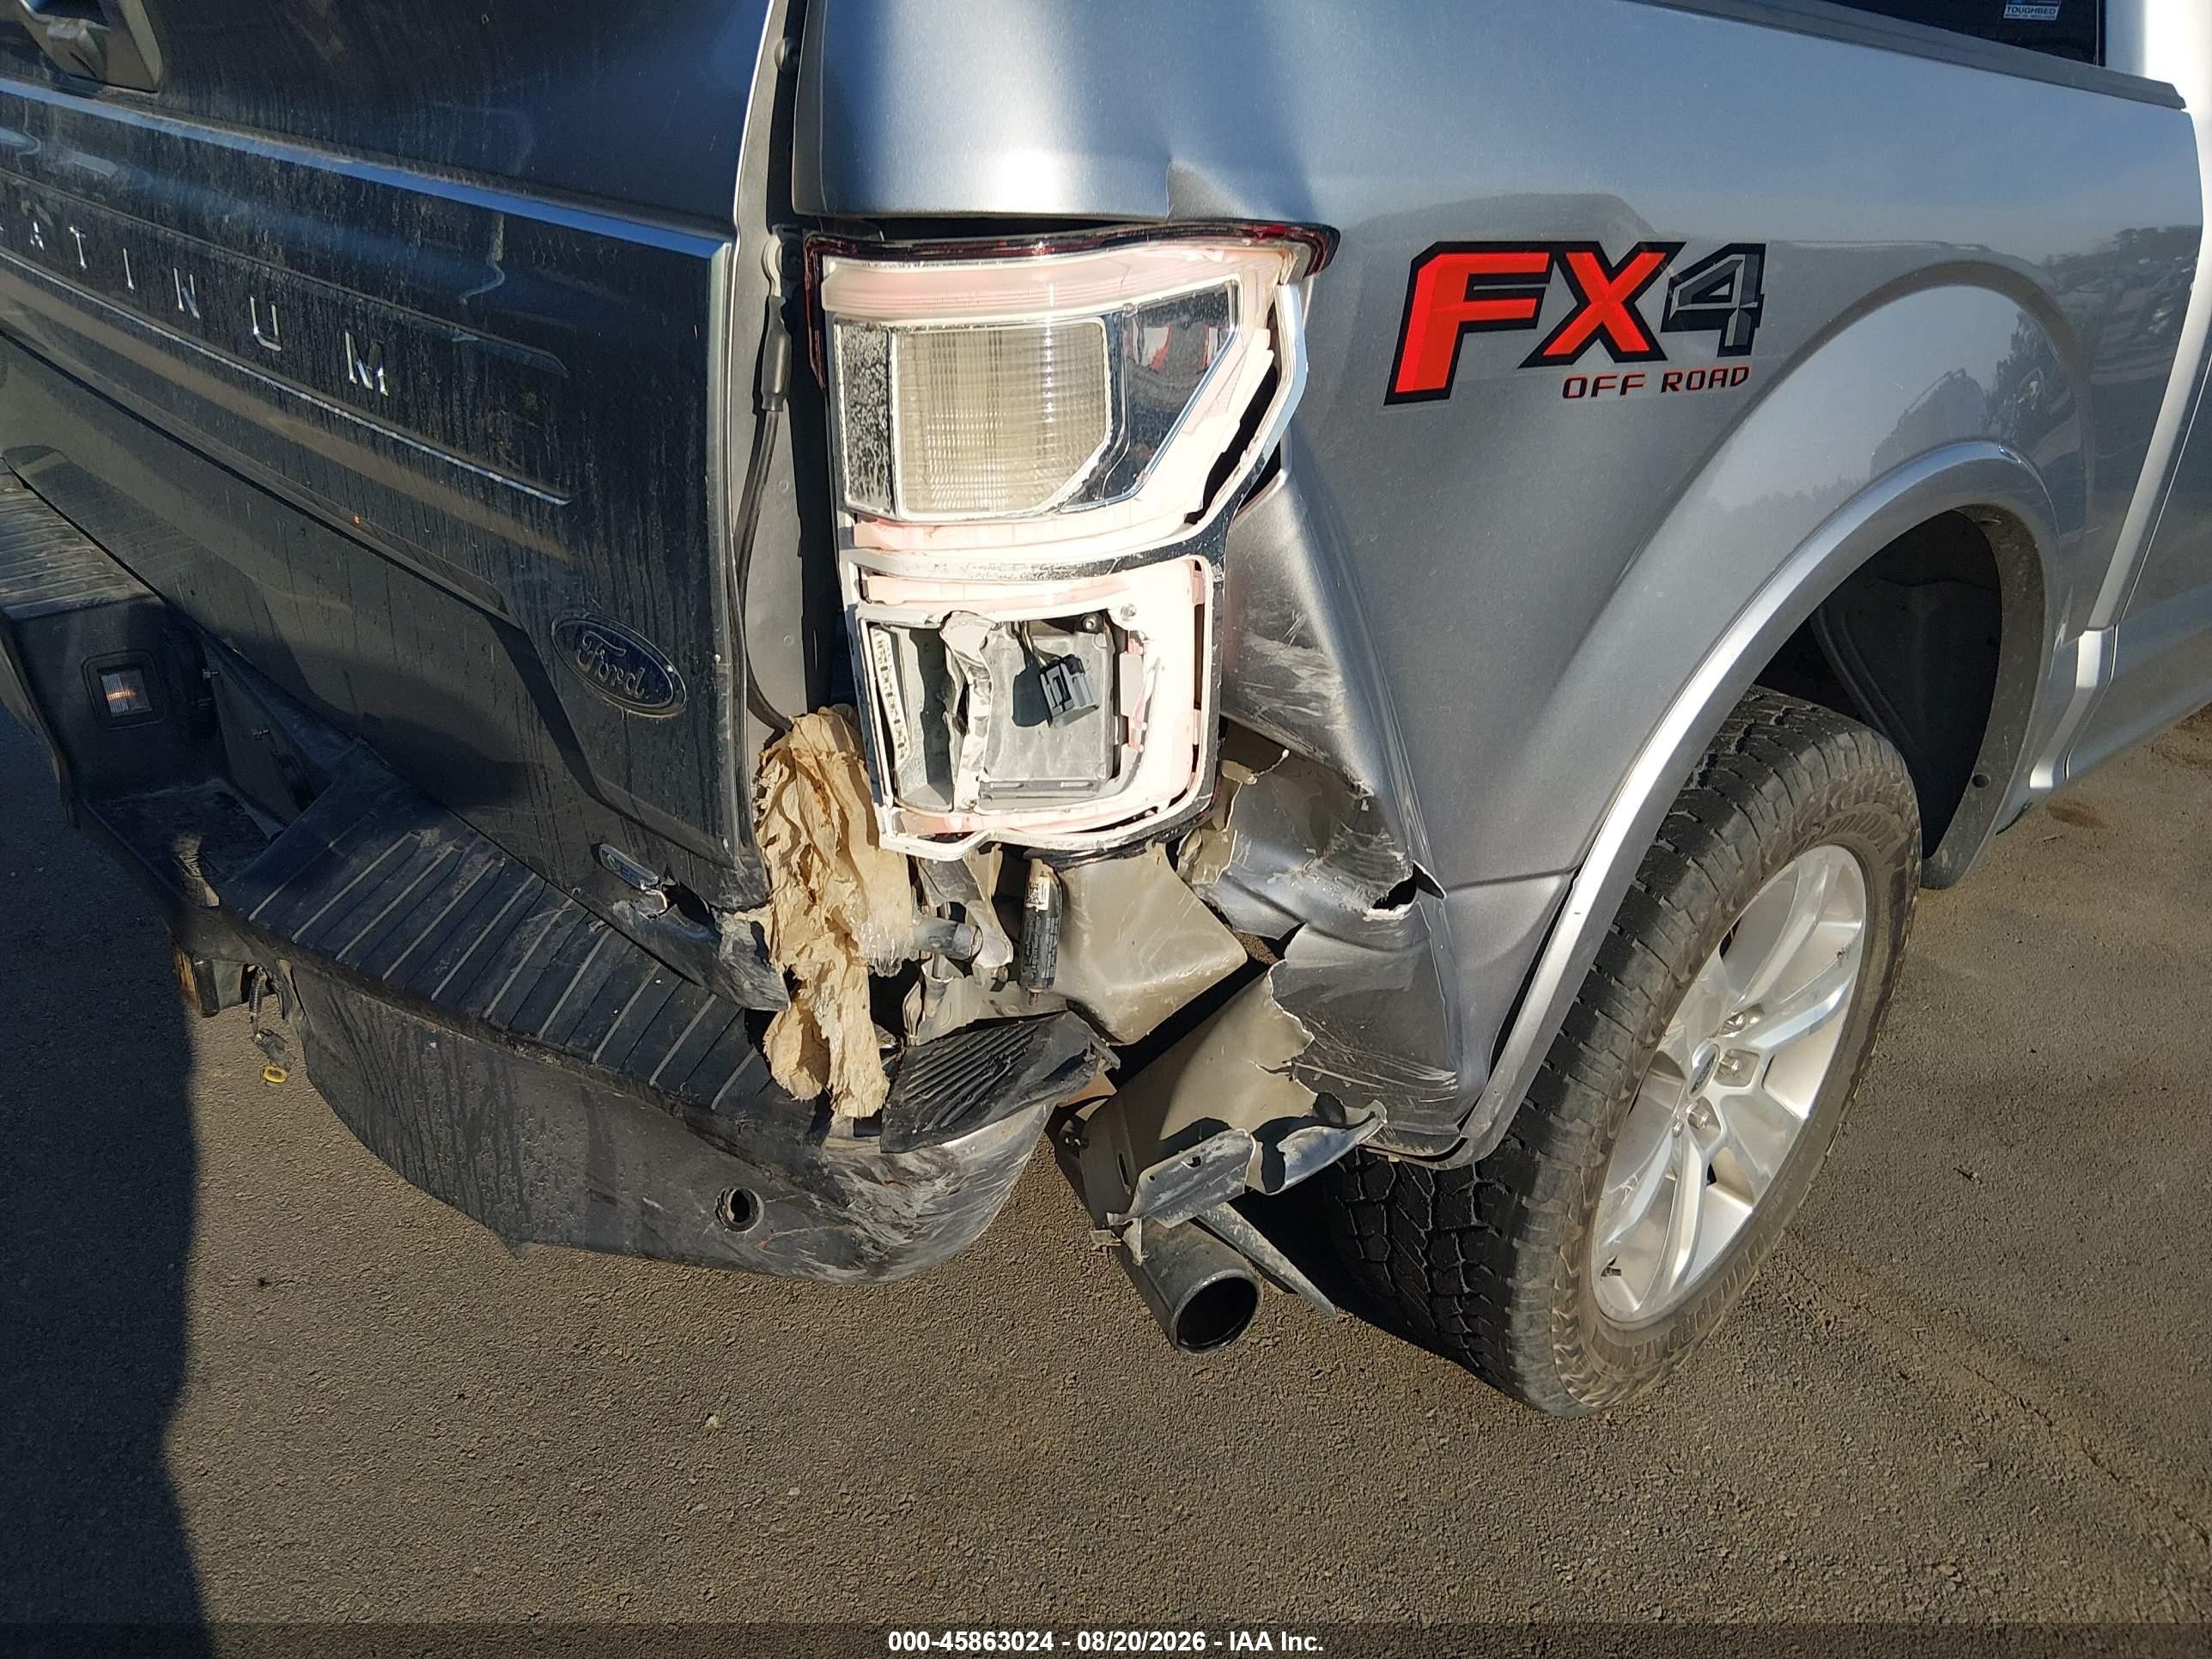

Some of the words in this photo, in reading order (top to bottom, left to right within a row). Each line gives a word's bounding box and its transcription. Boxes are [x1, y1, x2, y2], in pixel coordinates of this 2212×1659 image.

[2006, 5, 2057, 15] TOUGHBED
[1383, 241, 1767, 406] FX4
[1562, 373, 1648, 399] OFF
[1660, 366, 1751, 394] ROAD
[576, 630, 645, 699] Ford
